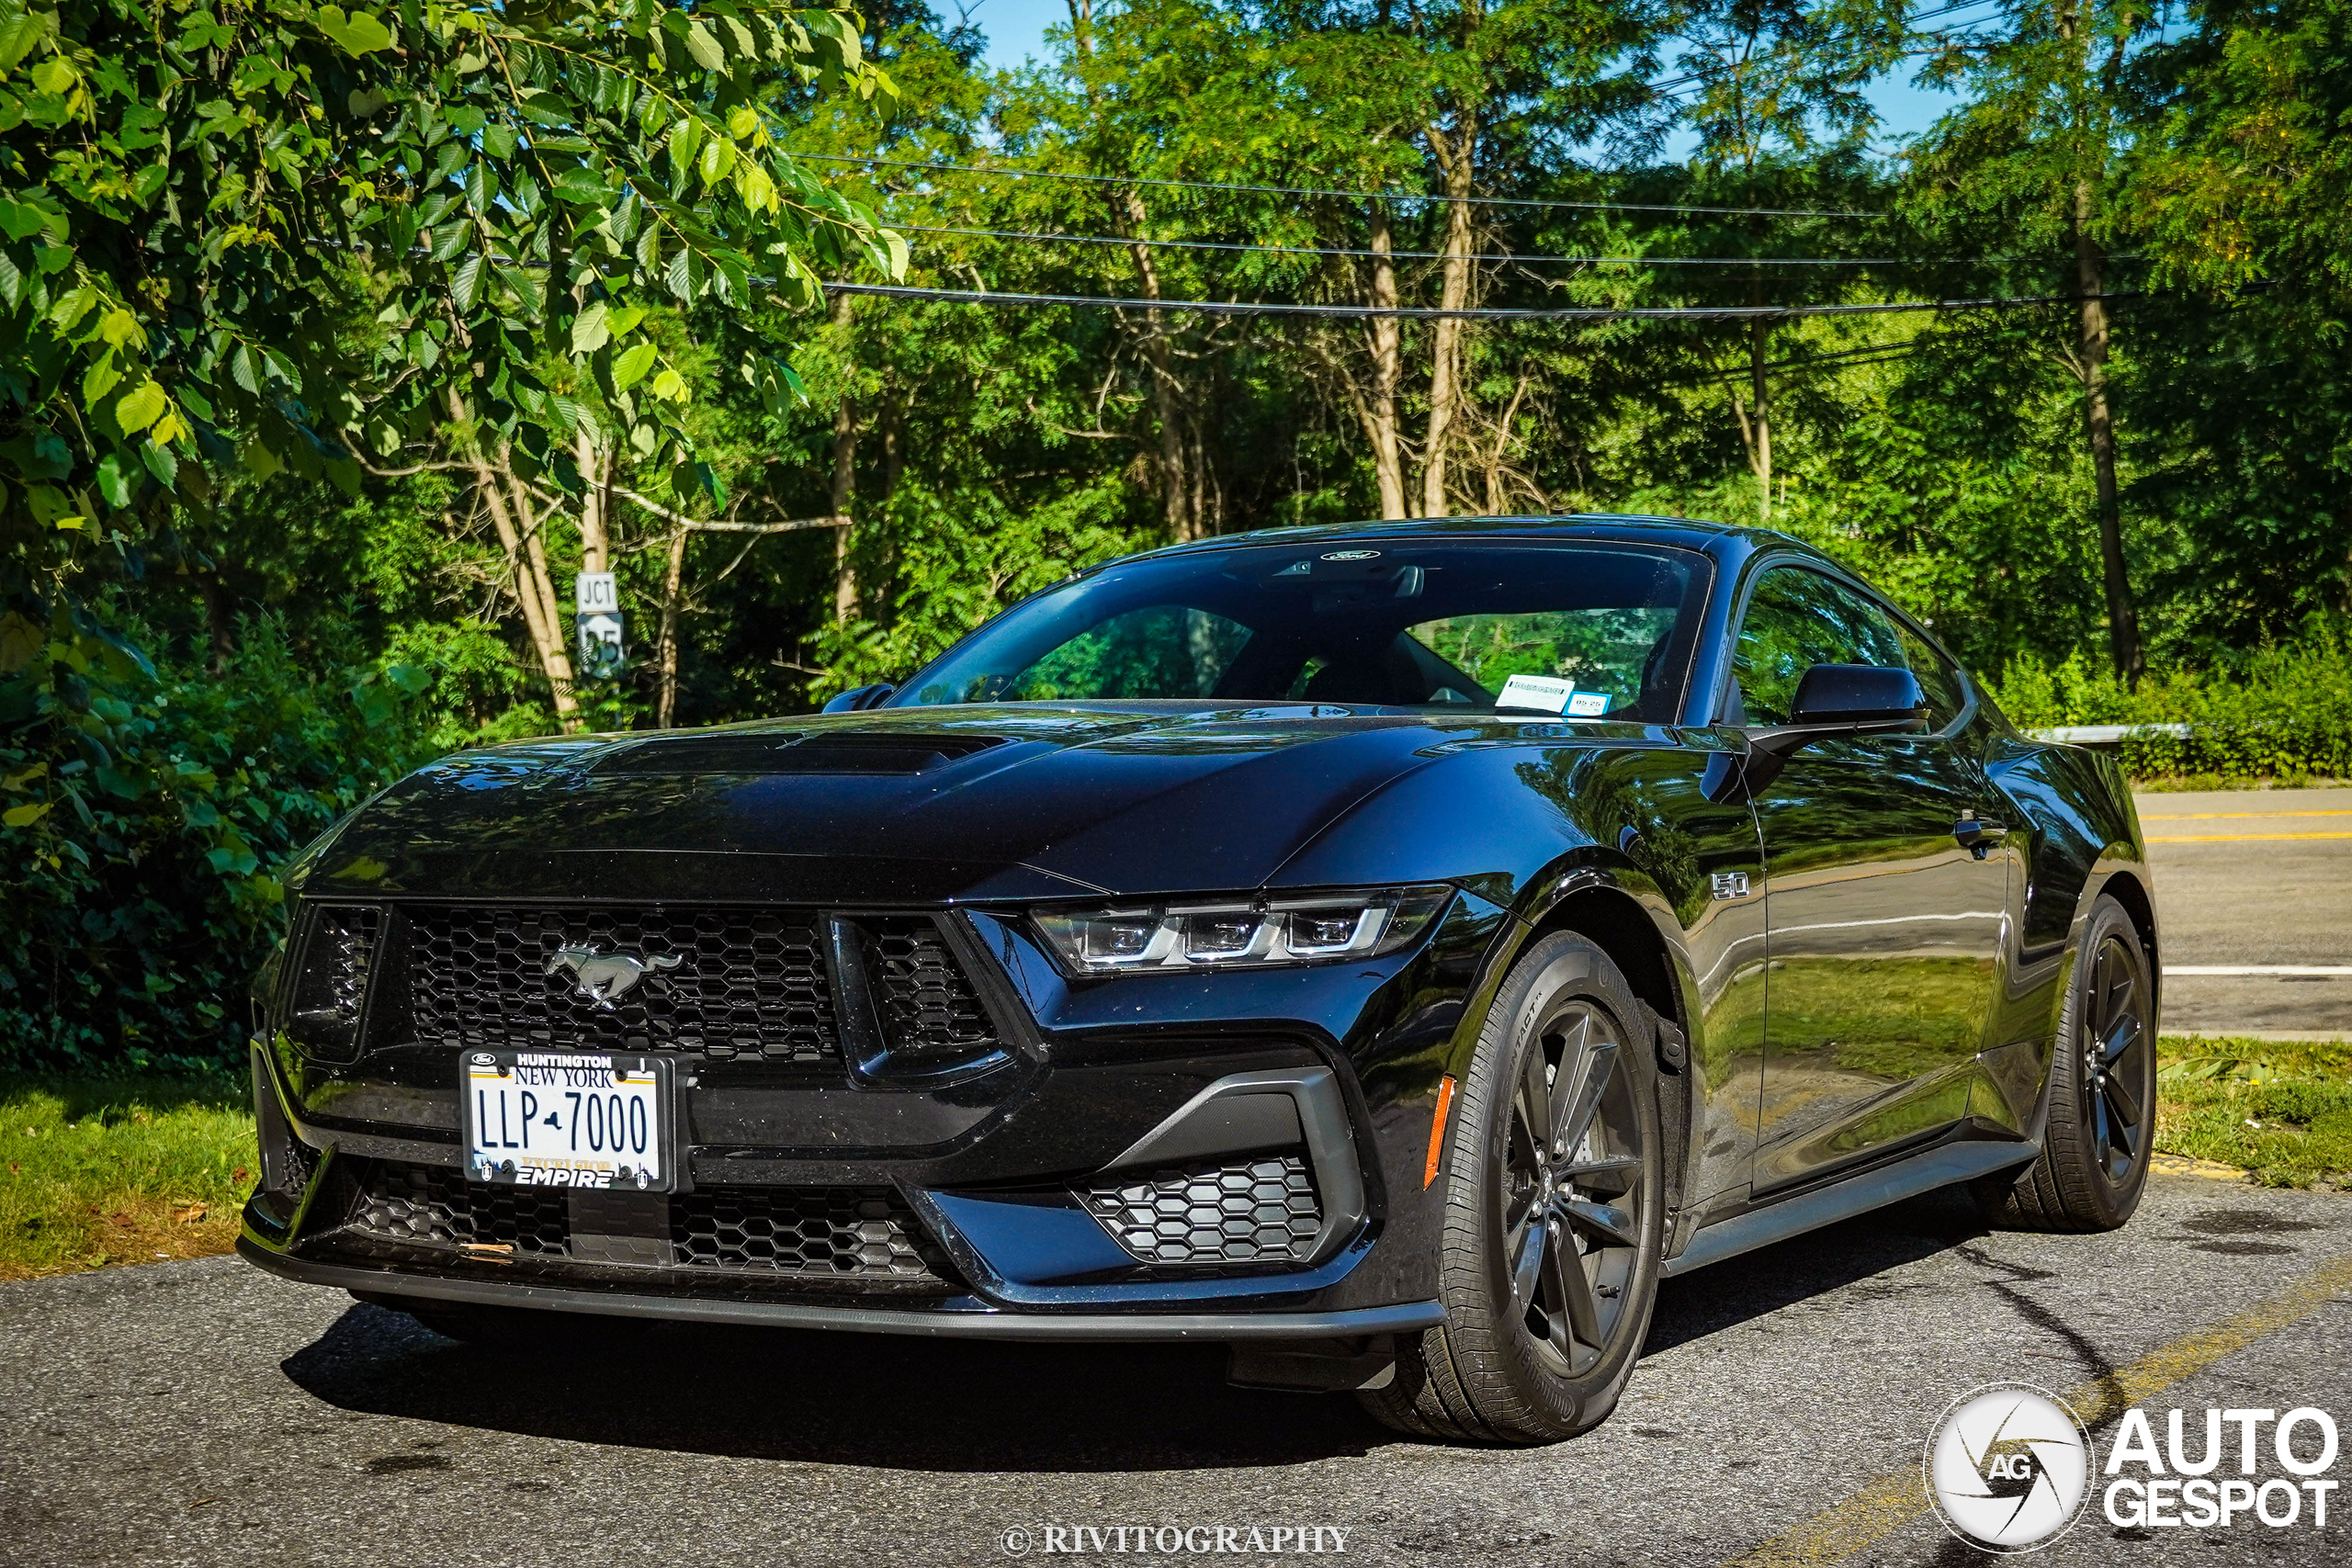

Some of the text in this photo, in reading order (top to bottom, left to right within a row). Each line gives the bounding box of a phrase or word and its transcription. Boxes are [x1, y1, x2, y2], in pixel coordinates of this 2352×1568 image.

[584, 581, 611, 604] JCT
[516, 1054, 612, 1068] HUNTINGTON
[514, 1068, 614, 1089] NEW YORK
[479, 1089, 647, 1155] LLP 7000
[515, 1168, 613, 1189] EMPIRE
